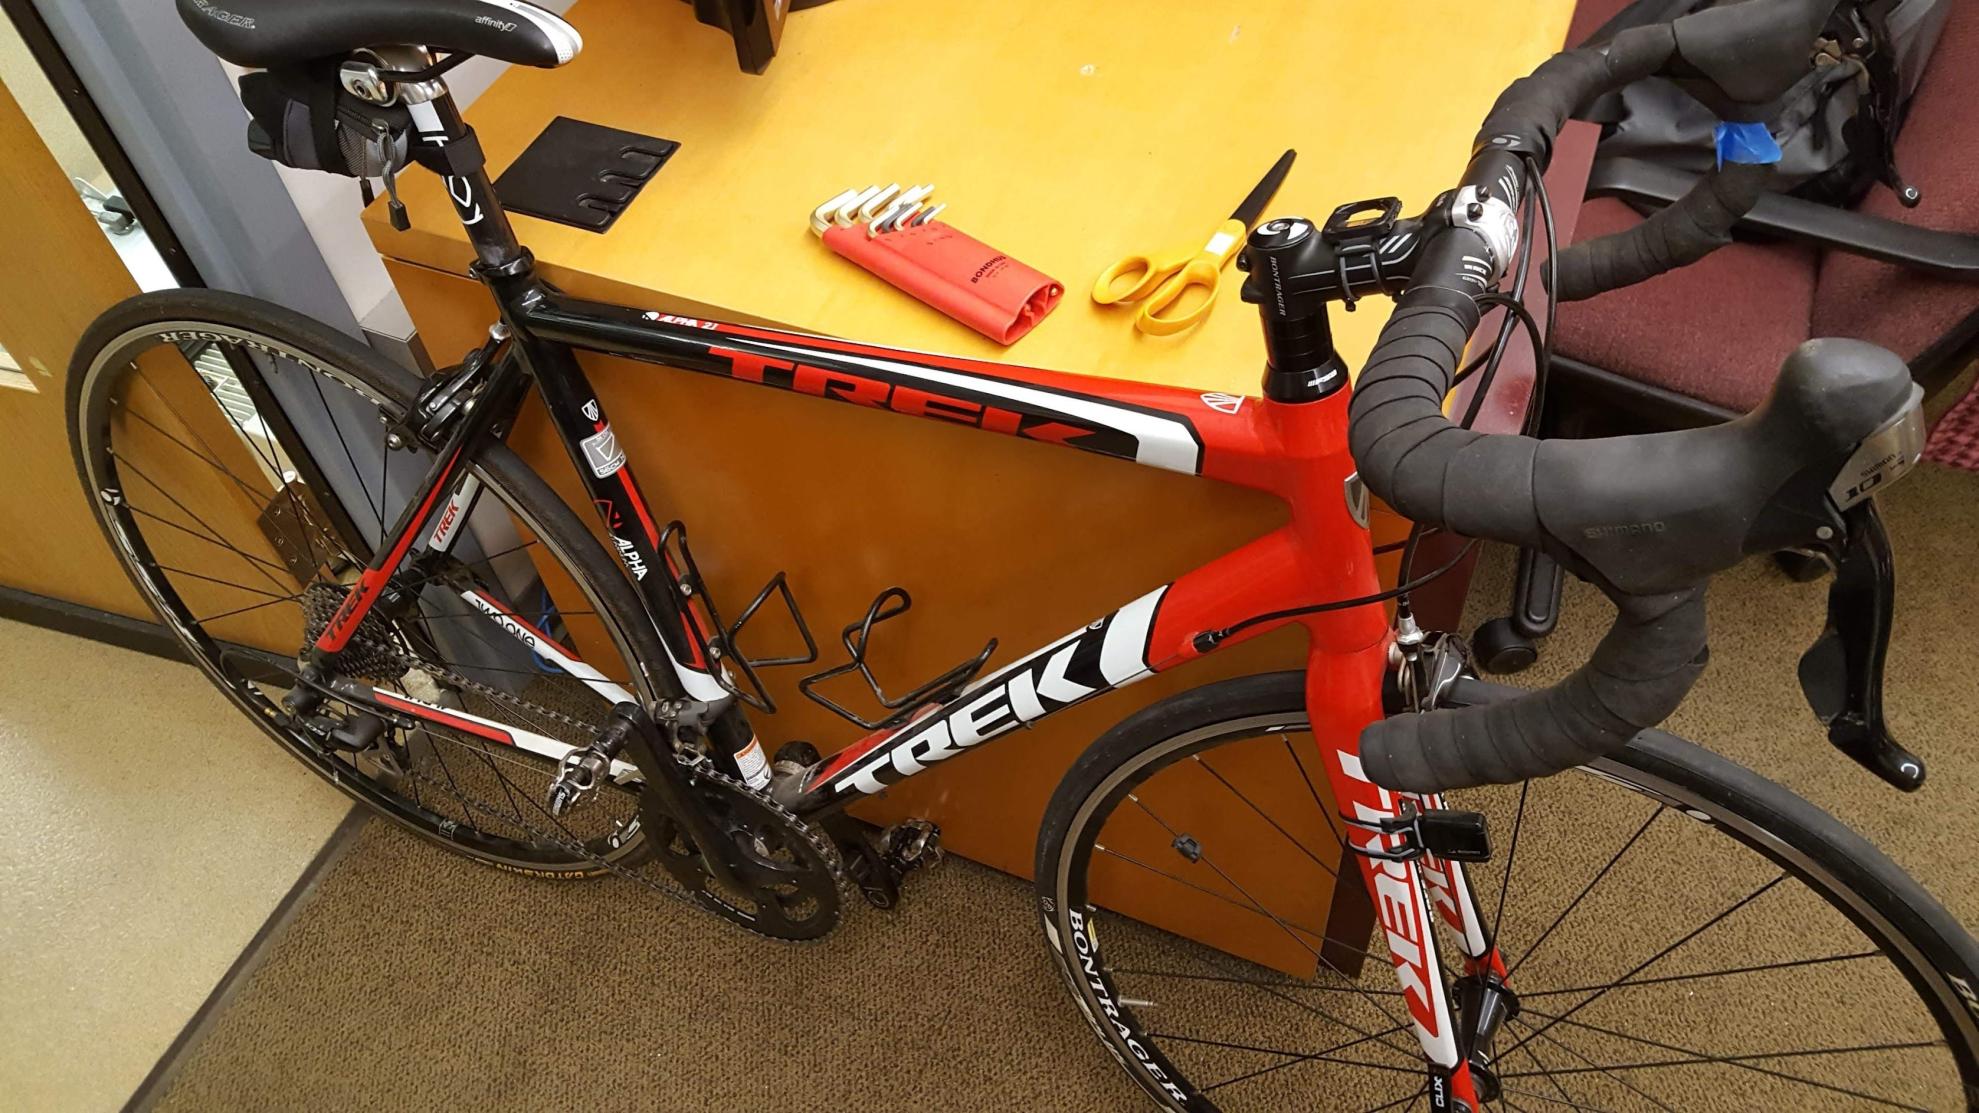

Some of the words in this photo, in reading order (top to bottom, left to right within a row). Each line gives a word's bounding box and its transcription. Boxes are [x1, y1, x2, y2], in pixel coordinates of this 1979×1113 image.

[474, 15, 505, 32] affinity
[1269, 256, 1287, 317] BONTRAGER
[657, 313, 699, 329] ALPHA
[159, 331, 381, 406] NTRAGER
[708, 346, 1095, 447] TREK
[433, 499, 460, 543] TREK
[1583, 521, 1665, 539] SHIMANO
[613, 534, 648, 581] ALPHA
[326, 579, 369, 640] TREK
[834, 639, 1097, 794] TREK
[1069, 908, 1188, 1106] BONTRAGER
[1433, 1076, 1444, 1108] CLIX
